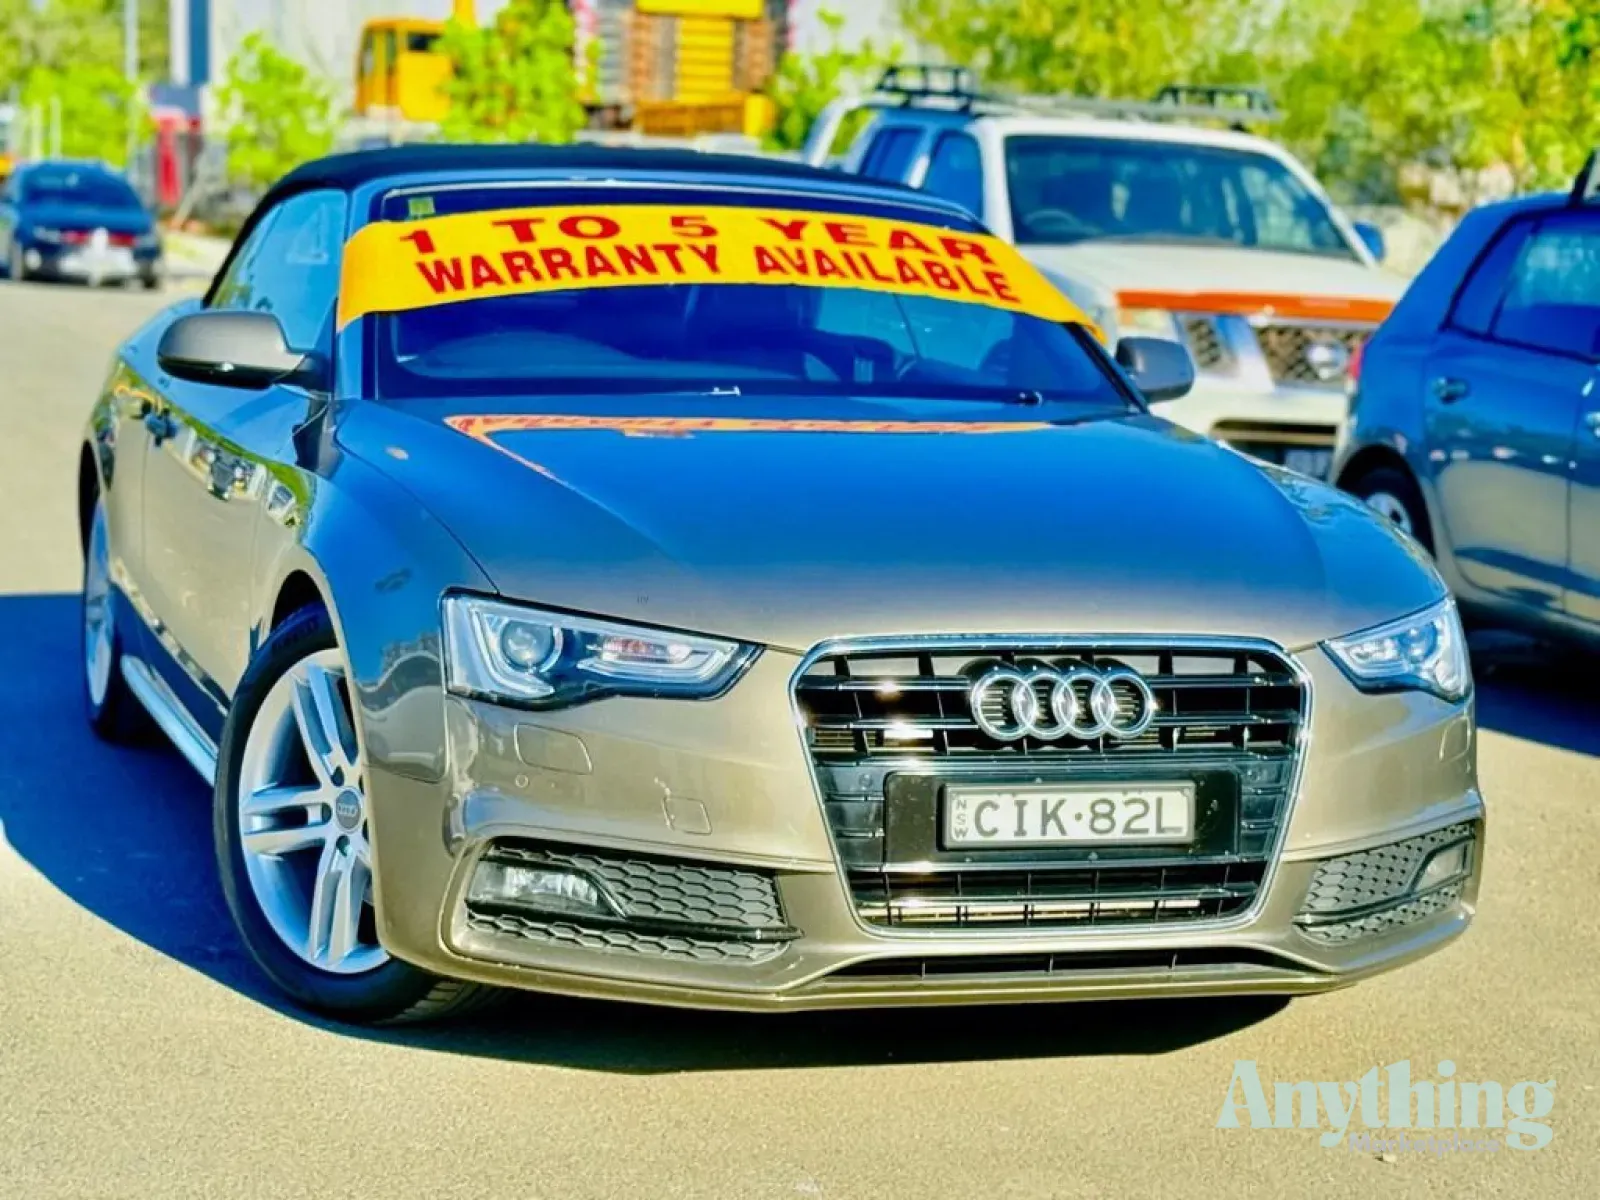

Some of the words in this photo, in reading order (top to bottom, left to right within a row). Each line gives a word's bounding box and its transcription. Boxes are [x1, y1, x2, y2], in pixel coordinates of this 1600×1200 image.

[401, 229, 436, 255] 1
[492, 215, 621, 244] TO
[670, 215, 718, 238] 5
[764, 217, 996, 266] YEAR
[414, 243, 721, 295] WARRANTY
[754, 244, 1021, 303] AVAILABLE
